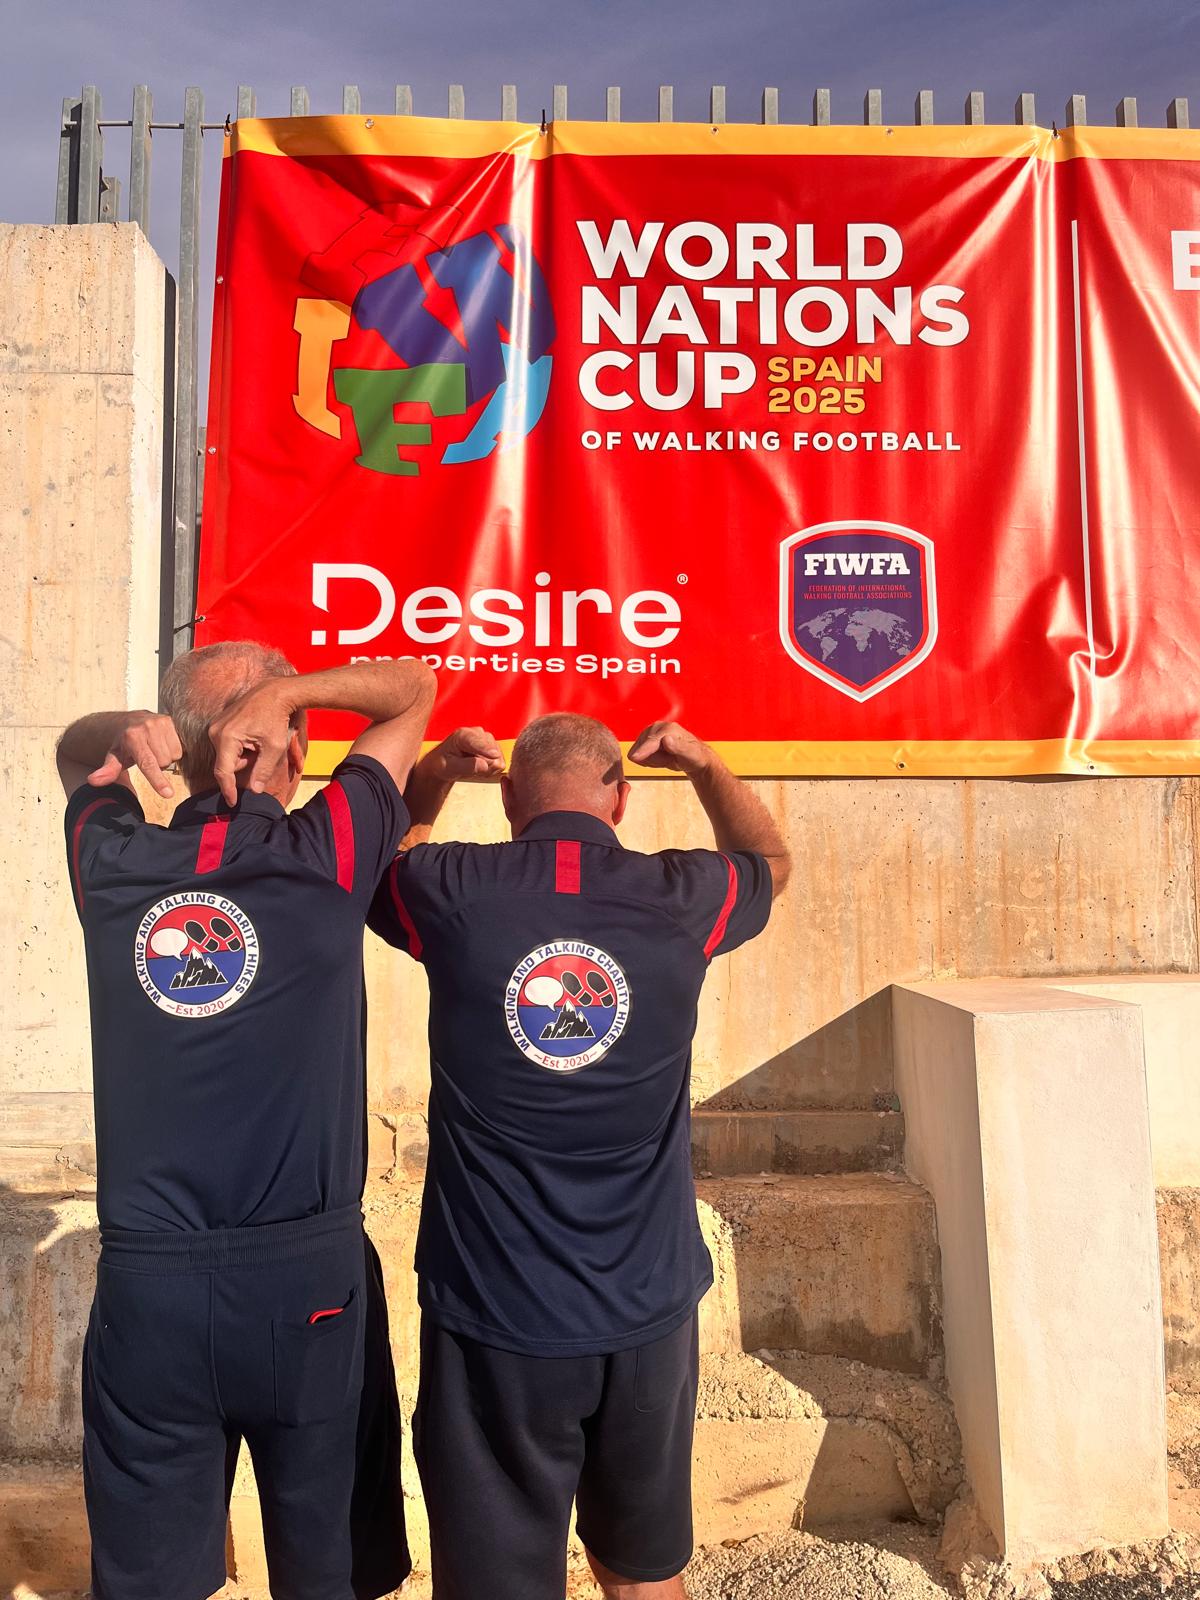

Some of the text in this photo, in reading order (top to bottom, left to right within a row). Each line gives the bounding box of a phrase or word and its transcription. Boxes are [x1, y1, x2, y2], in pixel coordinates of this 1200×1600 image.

[575, 219, 904, 282] WORLD
[581, 284, 970, 347] NATIONS
[578, 350, 757, 411] CUP
[767, 356, 882, 383] SPAIN
[768, 387, 866, 414] 2025
[581, 430, 961, 451] OF WALKING FOOTBALL
[804, 553, 911, 576] FIWFA
[803, 591, 912, 600] WALKING FOOTBALL ASSOCIATIONS
[808, 584, 906, 592] FEDERATION OF INTERNATIONAL
[350, 653, 681, 680] perties Spain
[136, 893, 258, 1004] WALKING AND TALKING CHARITY HIKES
[506, 942, 629, 1052] WALKING AND TALKING CHARITY HIKES
